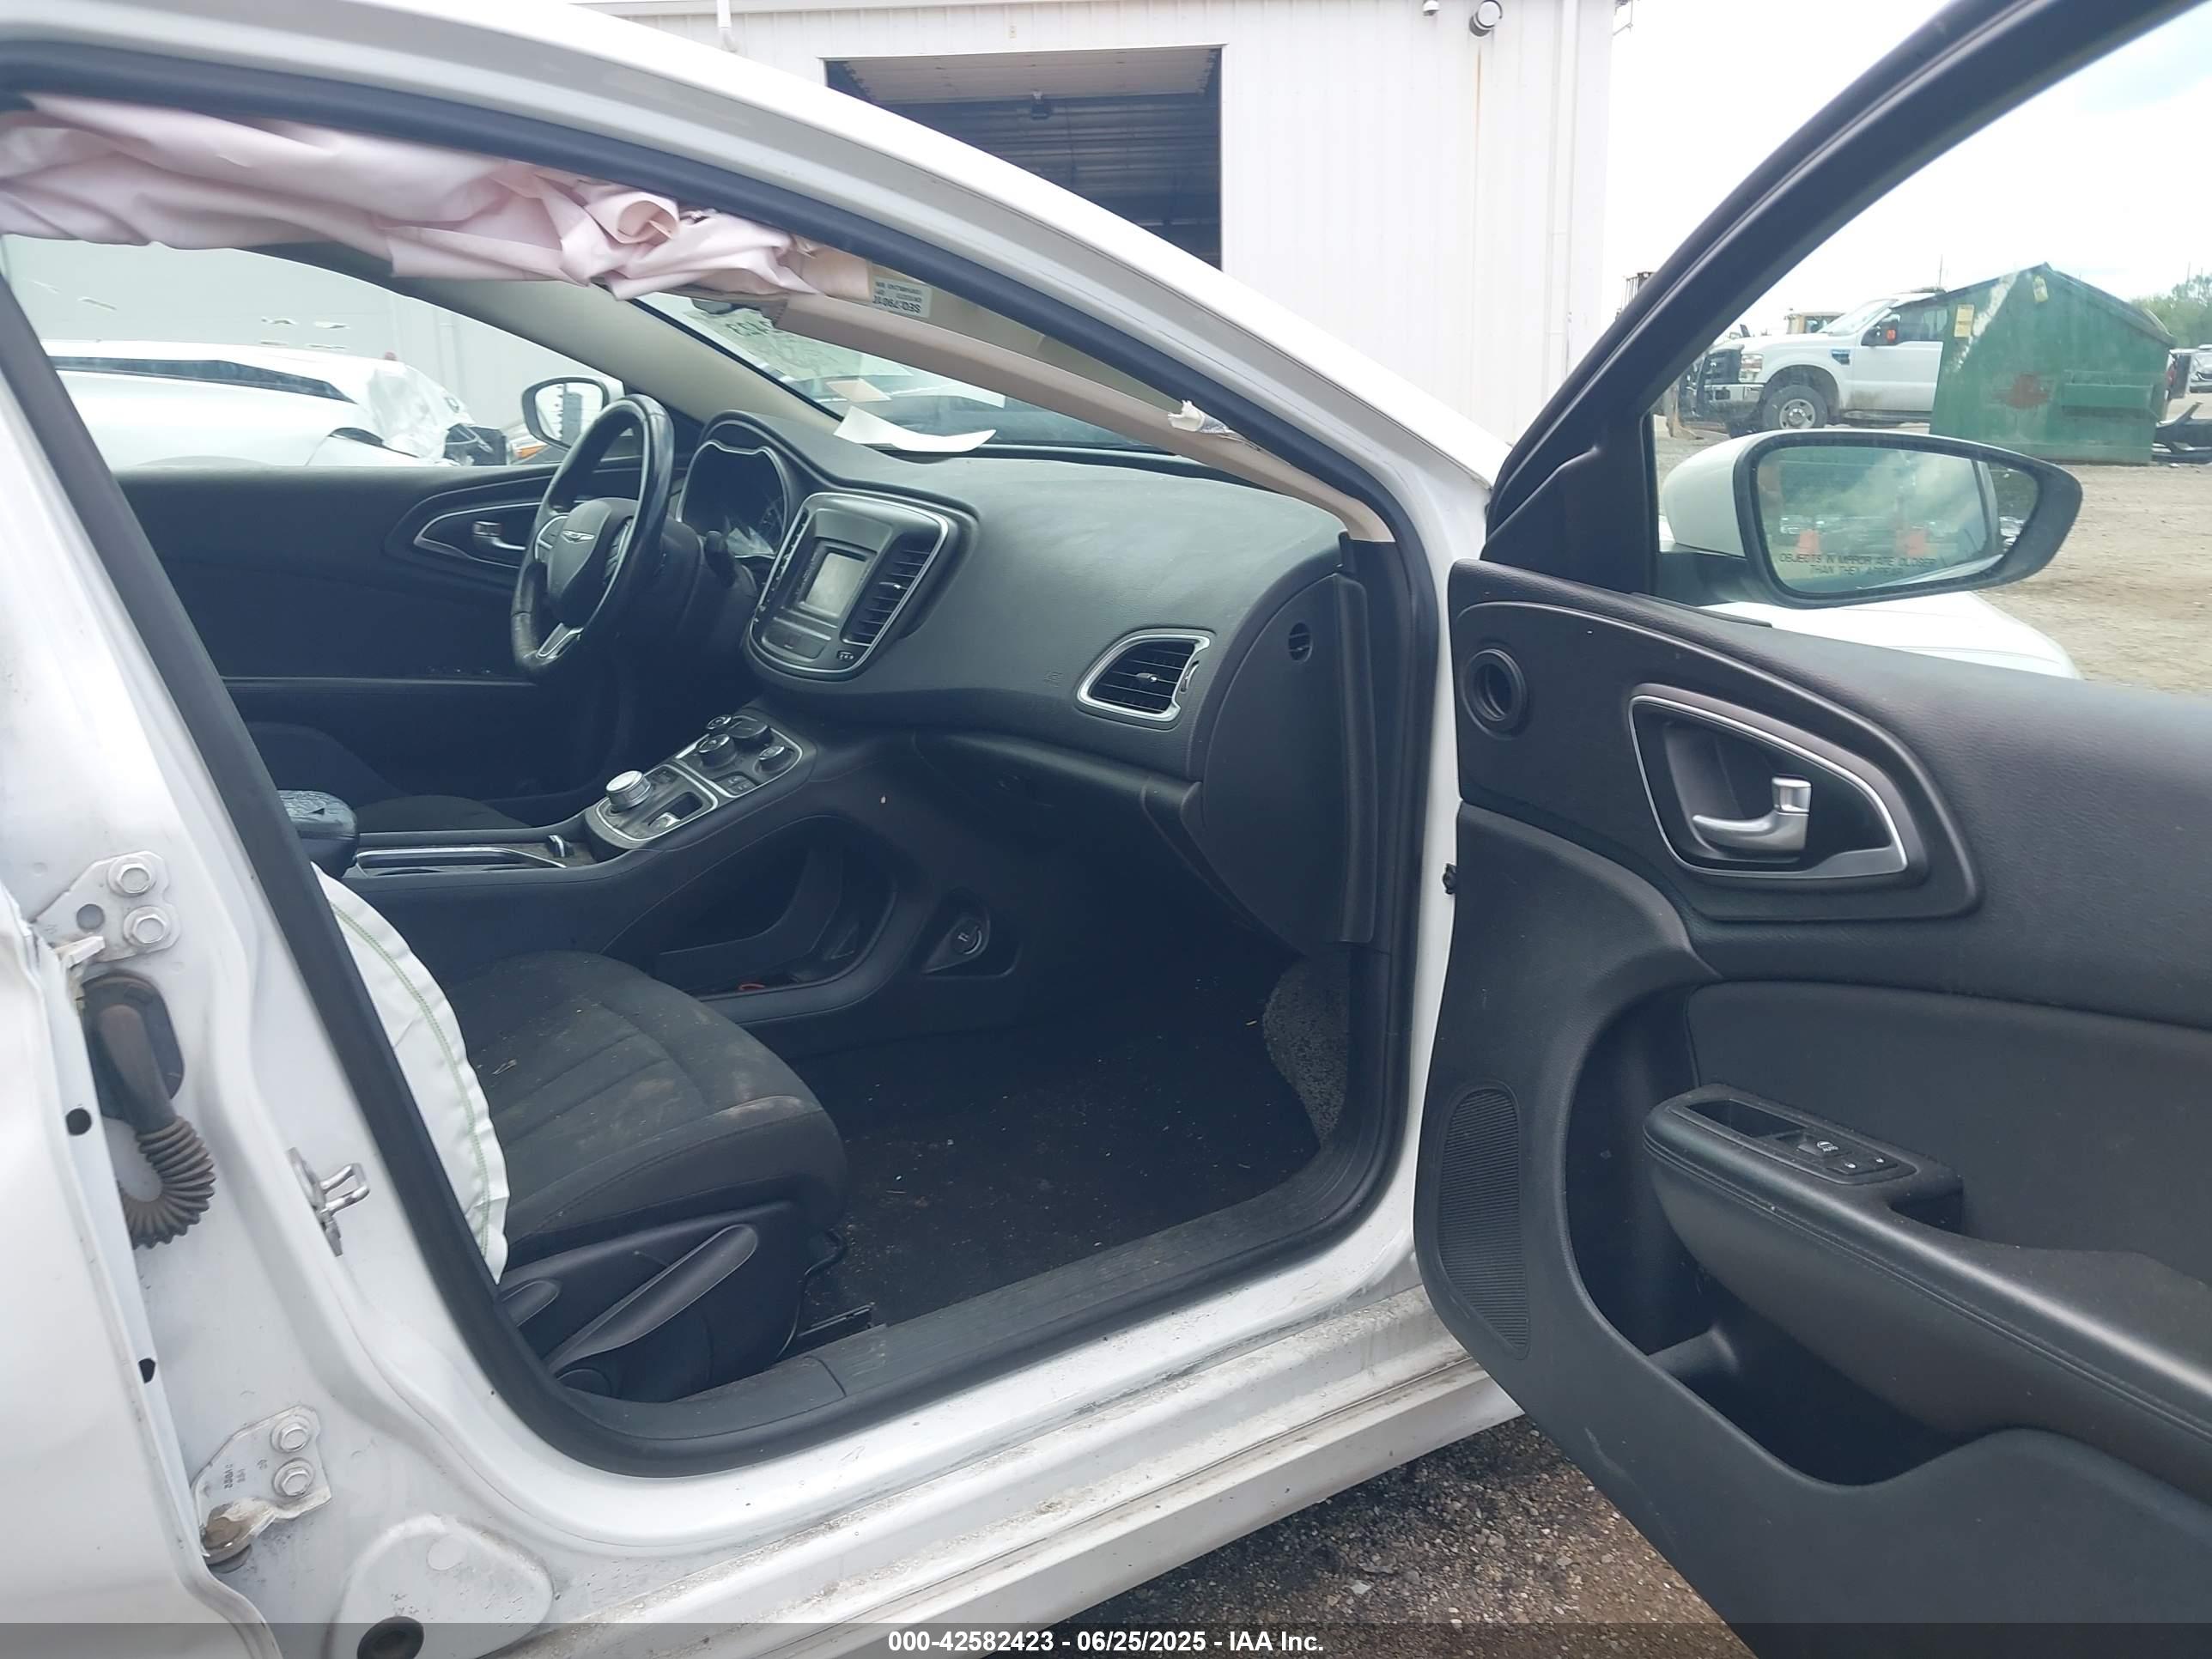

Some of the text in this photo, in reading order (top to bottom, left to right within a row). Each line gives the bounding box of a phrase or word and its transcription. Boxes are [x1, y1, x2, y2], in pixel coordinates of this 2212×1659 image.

[1778, 552, 1821, 563] OBJECTS
[1826, 554, 1835, 564] IN
[1837, 555, 1872, 565] MIRROR
[1898, 556, 1938, 568] CLOSER
[1808, 563, 1835, 574] THAN
[1839, 565, 1862, 576] THEY
